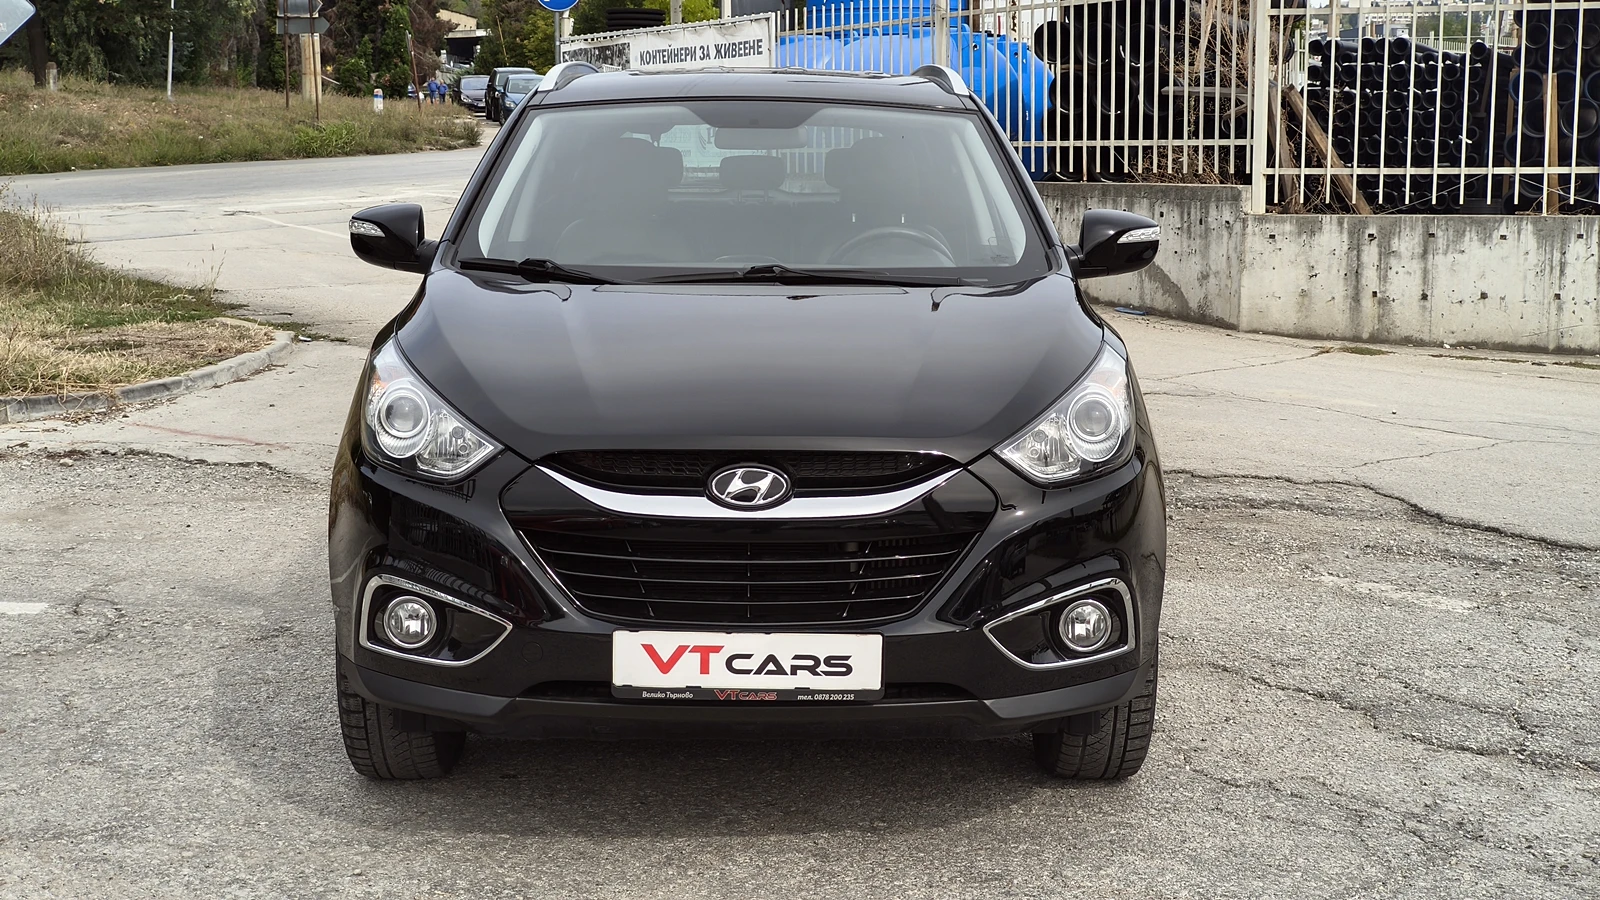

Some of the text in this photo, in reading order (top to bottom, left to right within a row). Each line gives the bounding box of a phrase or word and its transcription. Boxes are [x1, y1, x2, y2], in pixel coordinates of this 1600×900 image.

[640, 39, 763, 66] КОНТЕЙНЕРИ ЗА ЖИВЕЕНЕ
[666, 691, 693, 699] Търново
